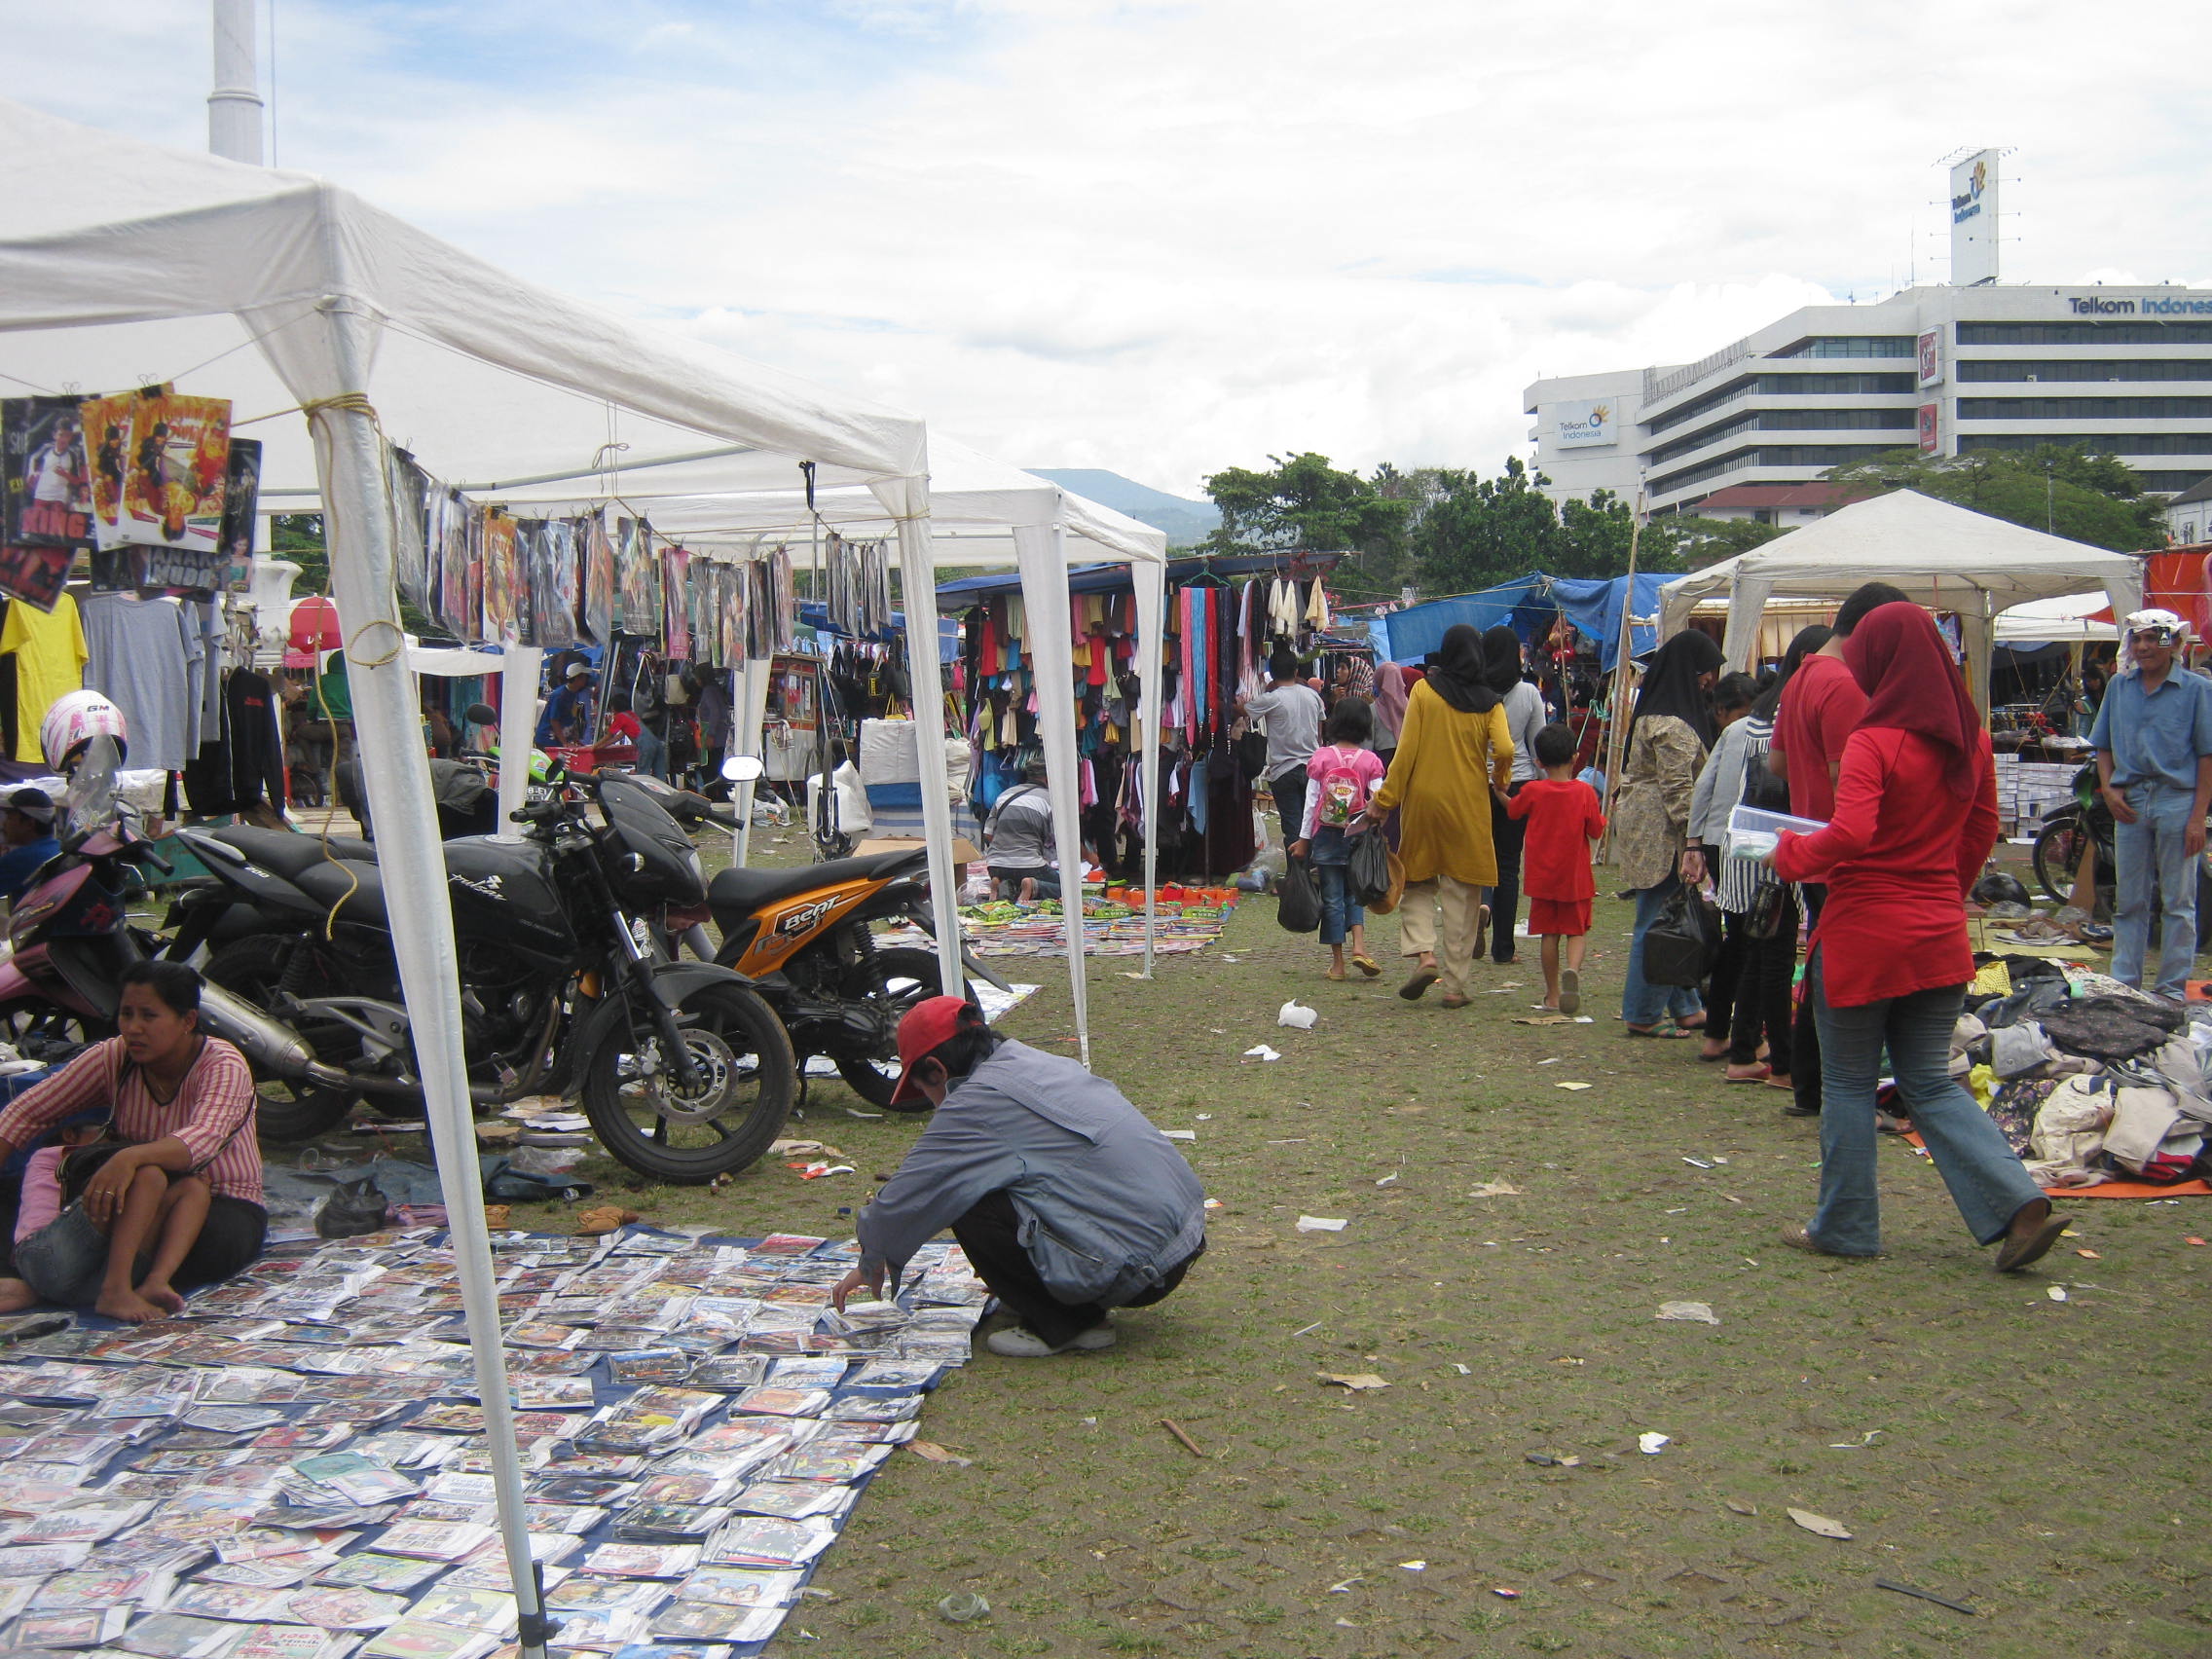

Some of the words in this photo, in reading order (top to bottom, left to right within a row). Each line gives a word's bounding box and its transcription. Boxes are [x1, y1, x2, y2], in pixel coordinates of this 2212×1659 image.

[2068, 296, 2134, 313] Telkom
[1559, 422, 1588, 430] Telkom
[1563, 429, 1602, 439] Indonesia
[21, 507, 87, 538] KING
[243, 866, 271, 878] 200
